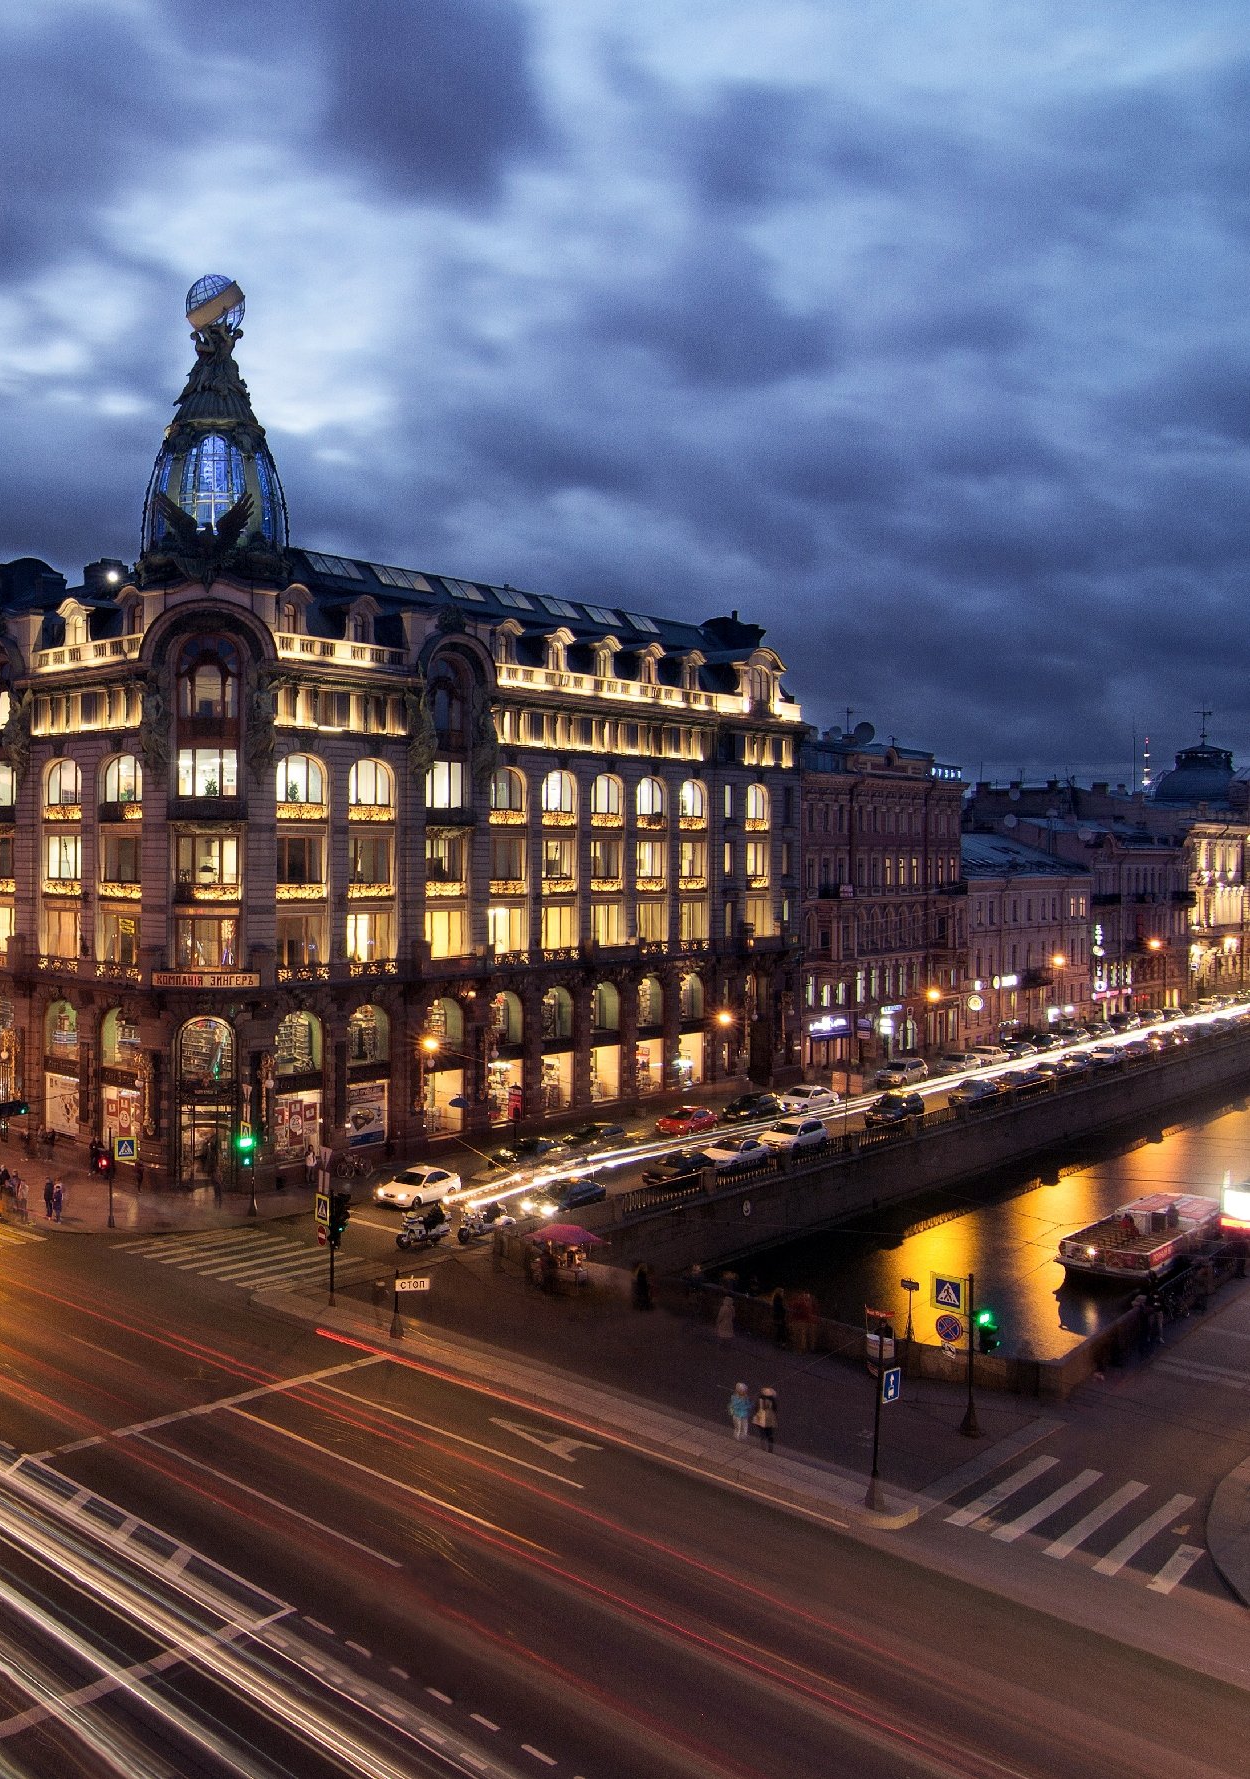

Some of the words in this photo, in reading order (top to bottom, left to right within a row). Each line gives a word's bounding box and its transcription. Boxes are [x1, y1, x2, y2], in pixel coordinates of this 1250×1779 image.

[156, 975, 203, 986] КОМПАНІЯ
[210, 975, 254, 987] ЗИНГЕРЪ
[400, 1280, 425, 1290] СТОП
